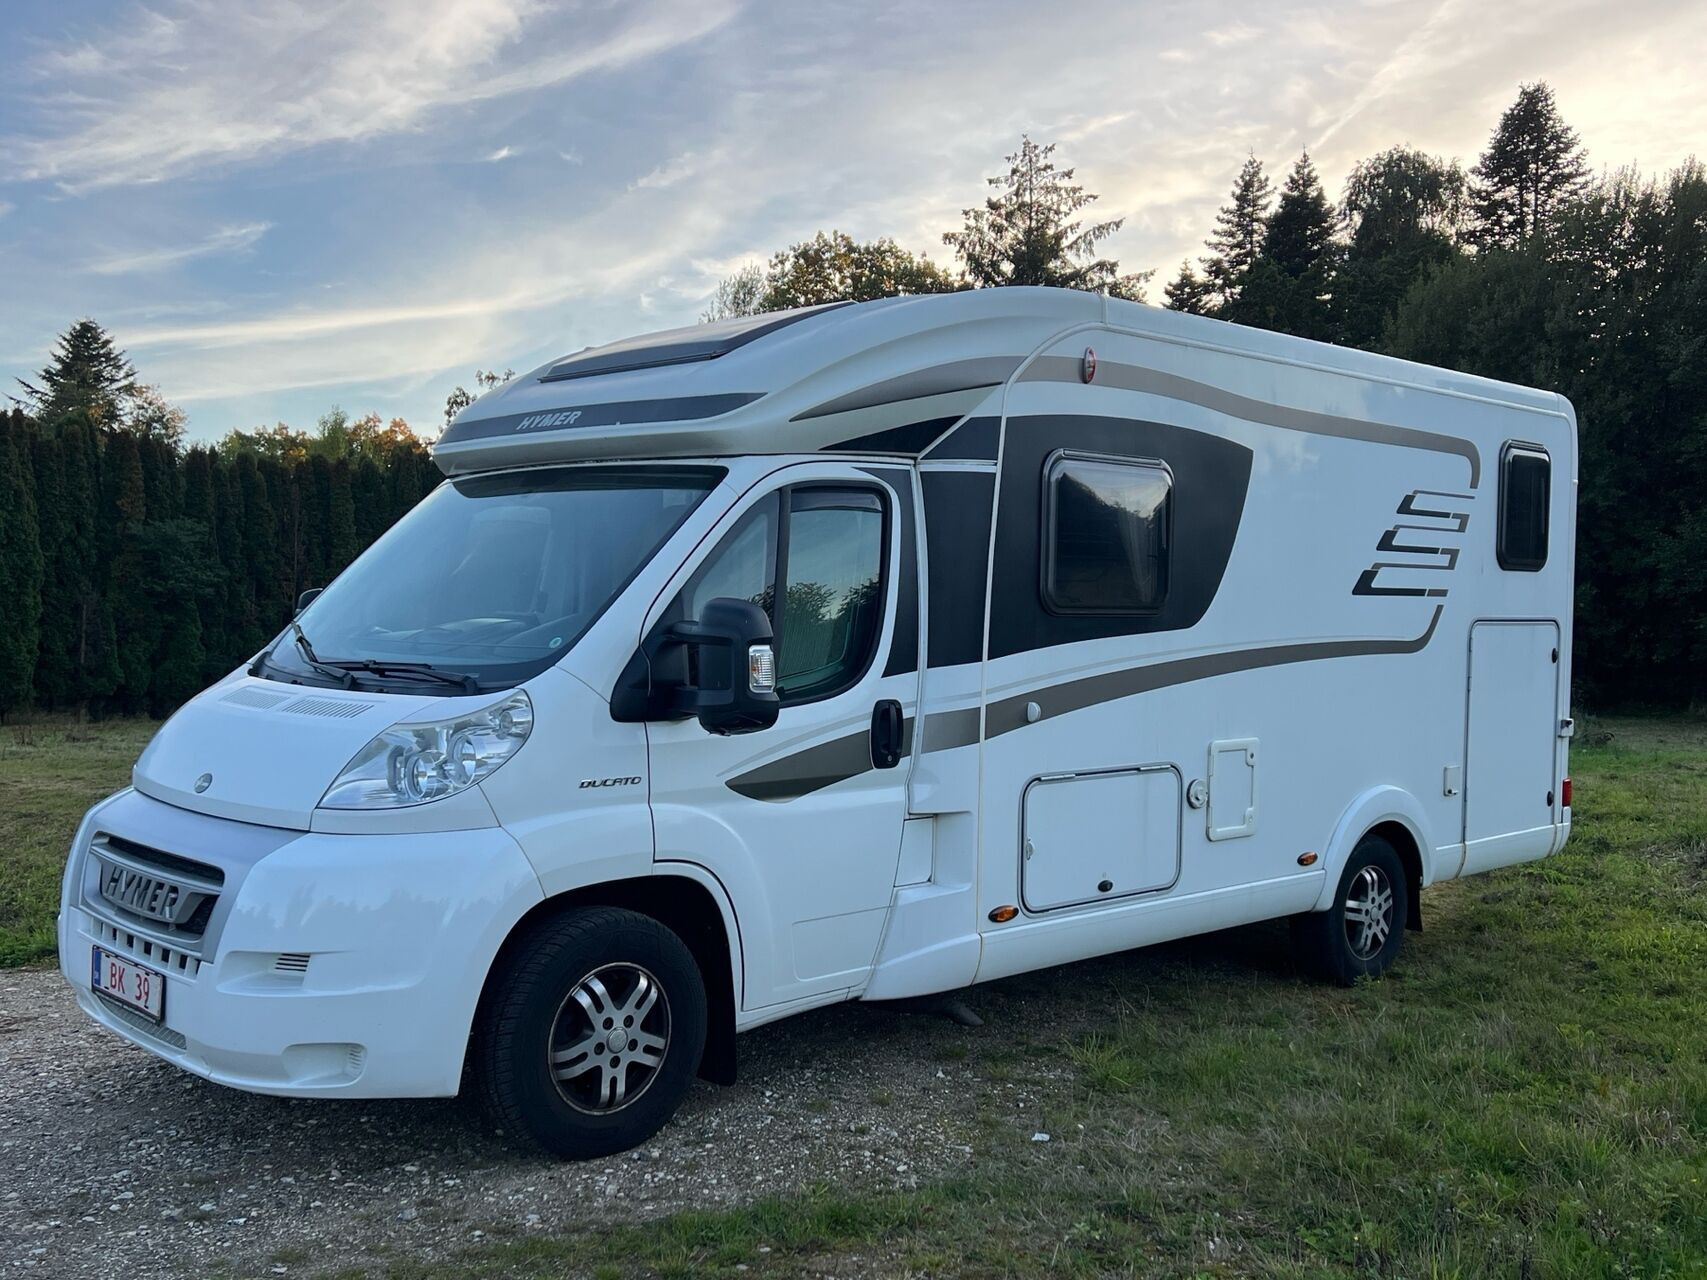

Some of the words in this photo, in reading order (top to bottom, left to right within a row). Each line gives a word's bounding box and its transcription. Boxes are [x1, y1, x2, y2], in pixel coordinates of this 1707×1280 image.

[516, 411, 582, 431] HYMER
[579, 776, 642, 789] DUCATO
[105, 865, 179, 920] HYMER
[110, 962, 126, 995] BK
[135, 973, 150, 1007] 39
